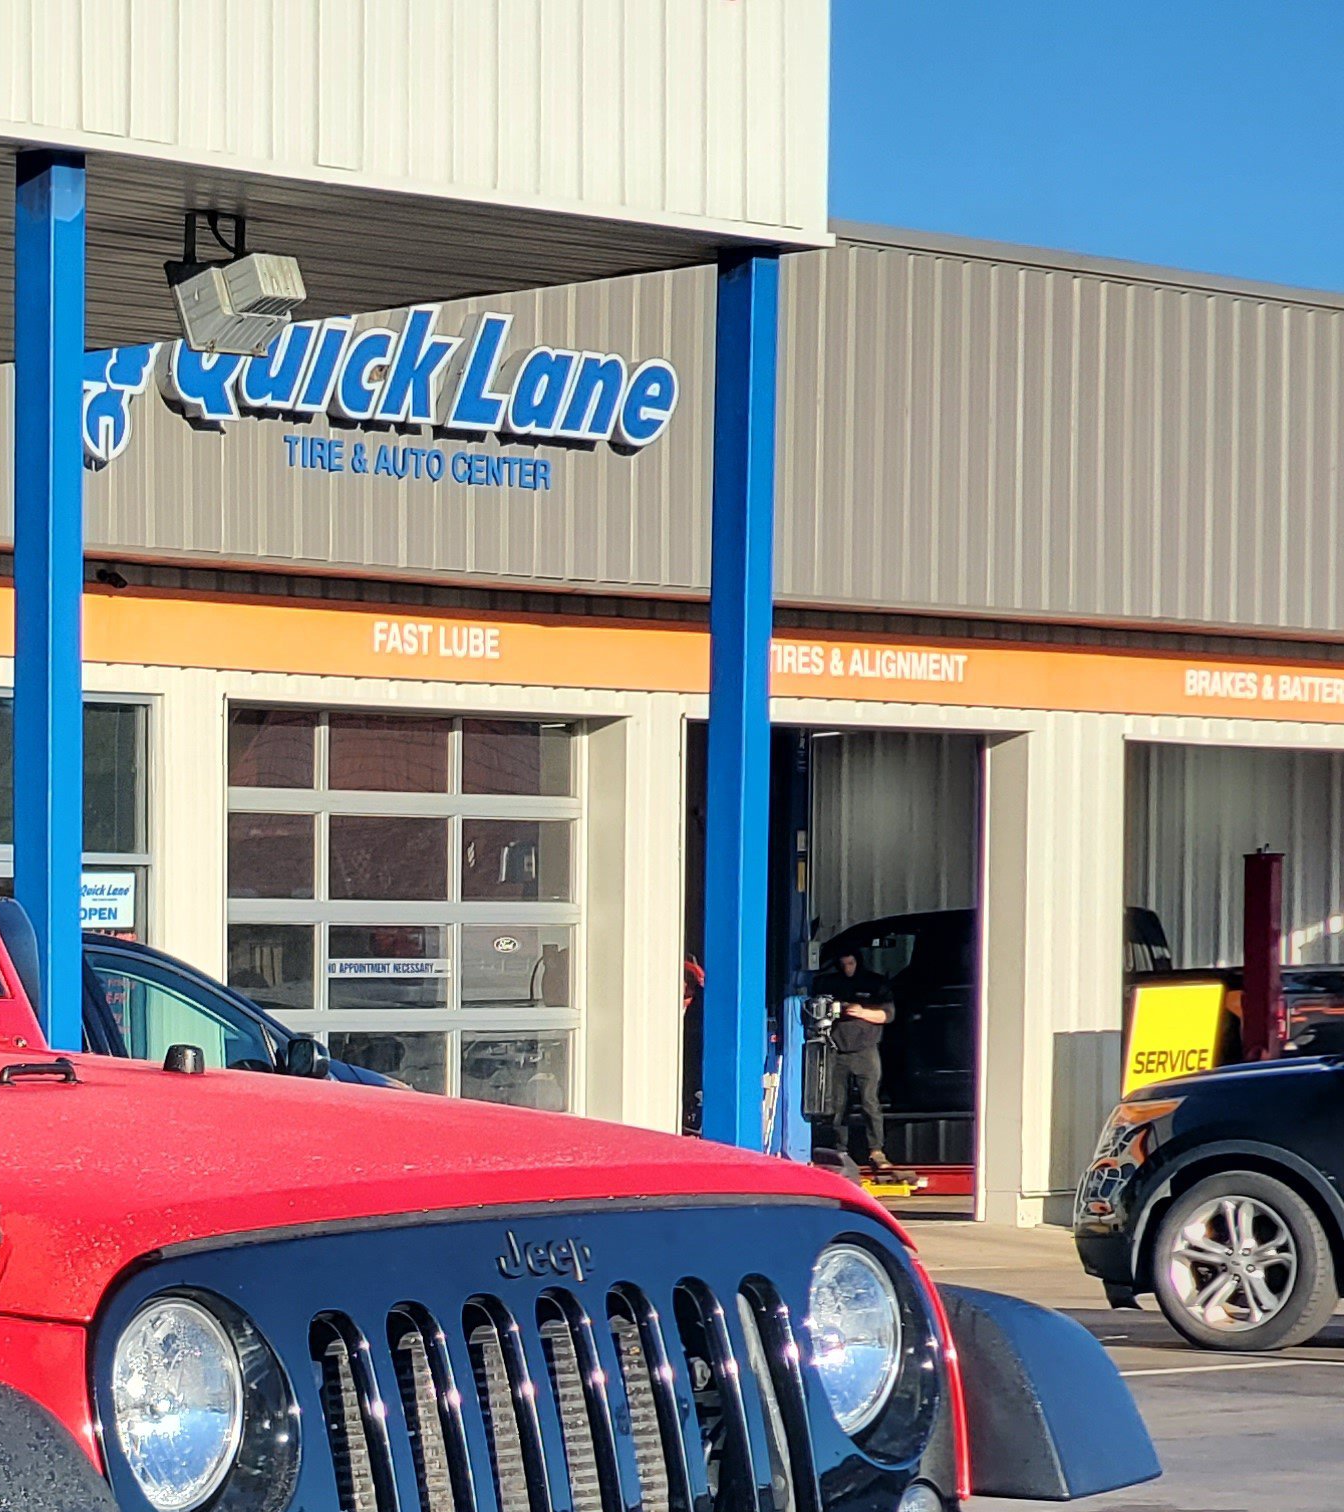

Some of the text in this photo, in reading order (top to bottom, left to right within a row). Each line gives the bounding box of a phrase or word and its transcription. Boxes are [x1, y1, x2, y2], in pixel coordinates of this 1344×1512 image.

[172, 304, 681, 448] Quick Lane
[283, 435, 553, 490] TIRE & AUTO CENTER
[373, 621, 500, 659] FAST LUBE
[829, 648, 845, 677] &
[849, 649, 969, 683] ALIGNMENT
[1184, 669, 1258, 700] BRAKES
[1262, 674, 1275, 700] &
[339, 963, 391, 974] APPOINTMENT
[392, 963, 434, 974] NECESSARY
[1132, 1048, 1209, 1075] SERVICE
[495, 1229, 595, 1283] Jeep
